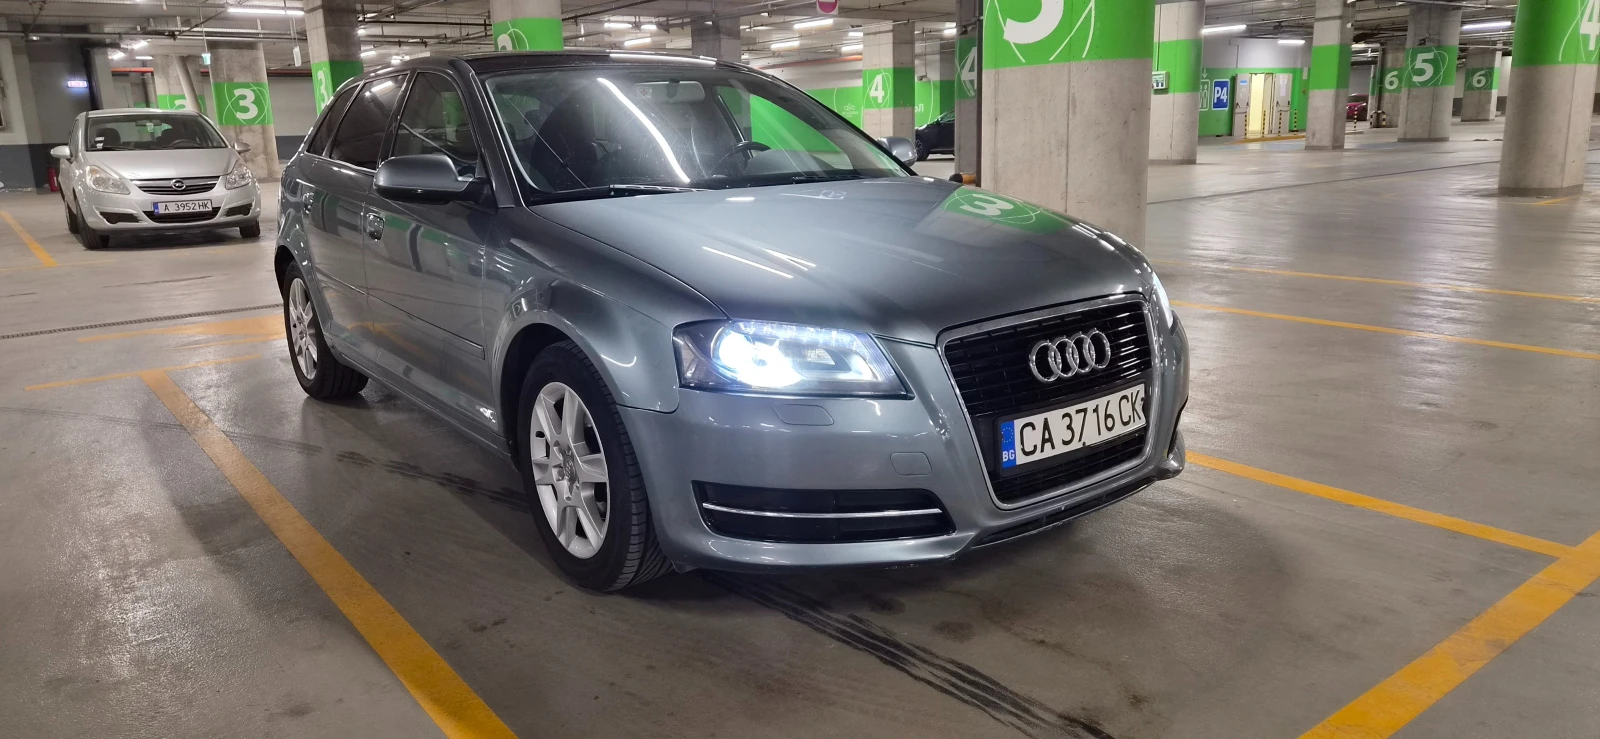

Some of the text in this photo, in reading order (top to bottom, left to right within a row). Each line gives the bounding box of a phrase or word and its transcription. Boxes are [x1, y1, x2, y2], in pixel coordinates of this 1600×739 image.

[1580, 0, 1600, 50] 4
[961, 47, 978, 90] 4
[1384, 71, 1399, 89] 6
[1412, 52, 1435, 82] 5
[1472, 70, 1487, 88] 6
[317, 70, 329, 109] 3
[869, 74, 884, 103] 4
[1213, 86, 1228, 103] P4
[233, 88, 258, 119] 3
[164, 204, 170, 212] A
[174, 203, 197, 211] 3952
[197, 201, 210, 210] HK
[1019, 390, 1142, 456] CA 3716 CK
[1002, 450, 1015, 461] BG
